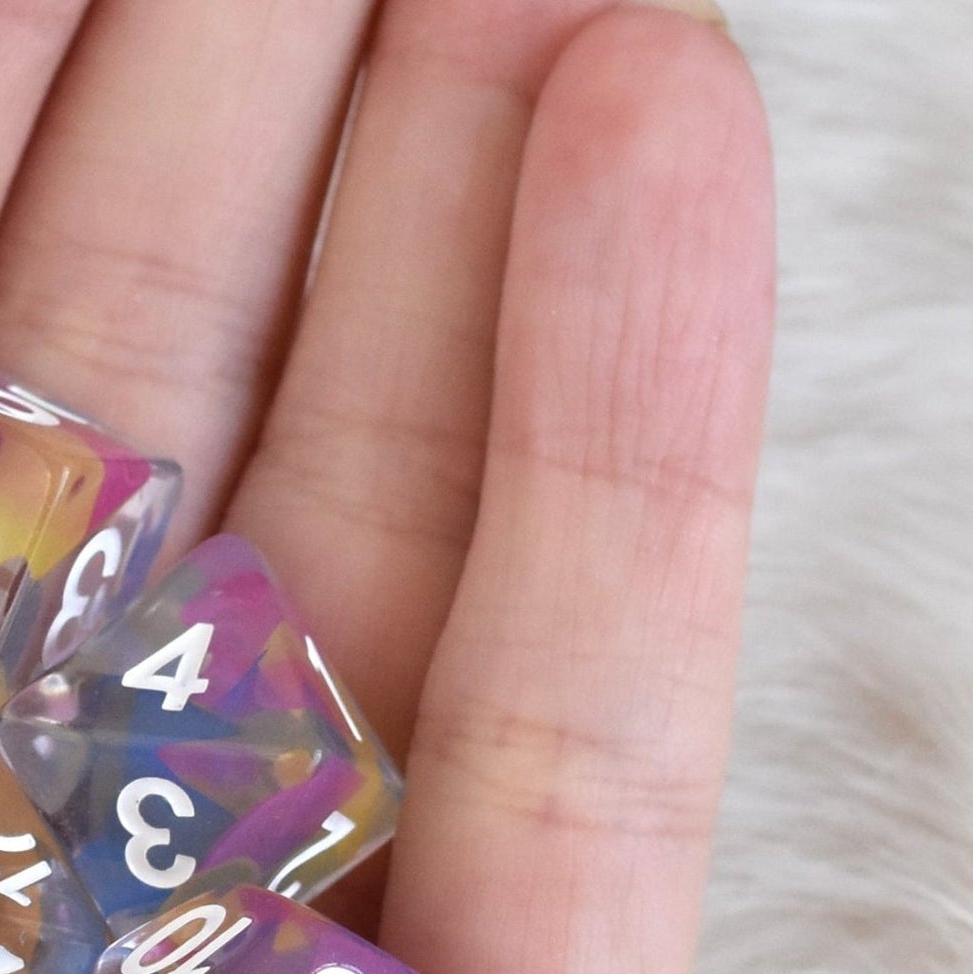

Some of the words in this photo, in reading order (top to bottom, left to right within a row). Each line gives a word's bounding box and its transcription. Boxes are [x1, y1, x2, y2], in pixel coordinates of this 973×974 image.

[41, 527, 122, 669] 3
[122, 622, 215, 712] 4
[116, 777, 196, 889] 3
